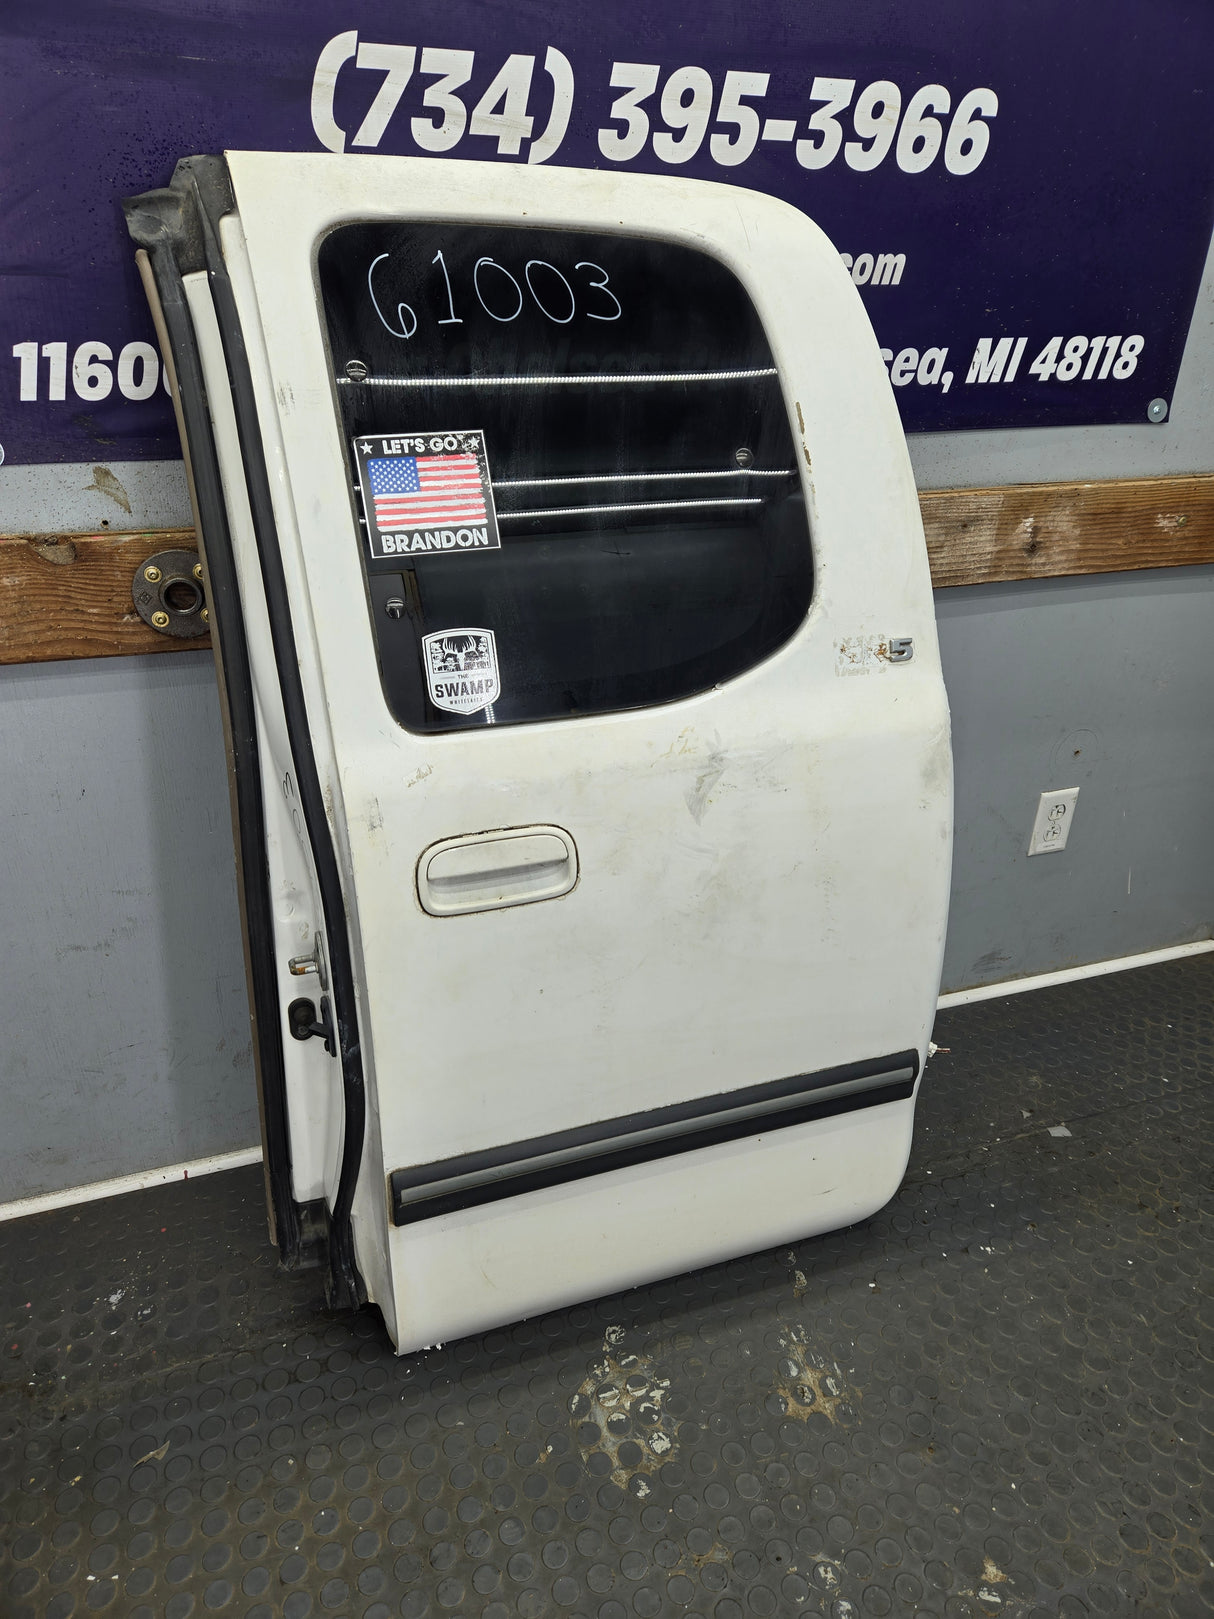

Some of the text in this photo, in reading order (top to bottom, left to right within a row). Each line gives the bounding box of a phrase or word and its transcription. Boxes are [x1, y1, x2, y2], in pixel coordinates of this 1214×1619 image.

[310, 30, 999, 176] (734) 395-3966
[367, 250, 622, 339] 61003
[12, 341, 177, 402] 1160
[965, 337, 1029, 384] MI
[1028, 334, 1145, 382] 48118
[382, 436, 458, 454] LET'S GO
[381, 528, 489, 553] BRANDON
[434, 679, 494, 699] SWAMP
